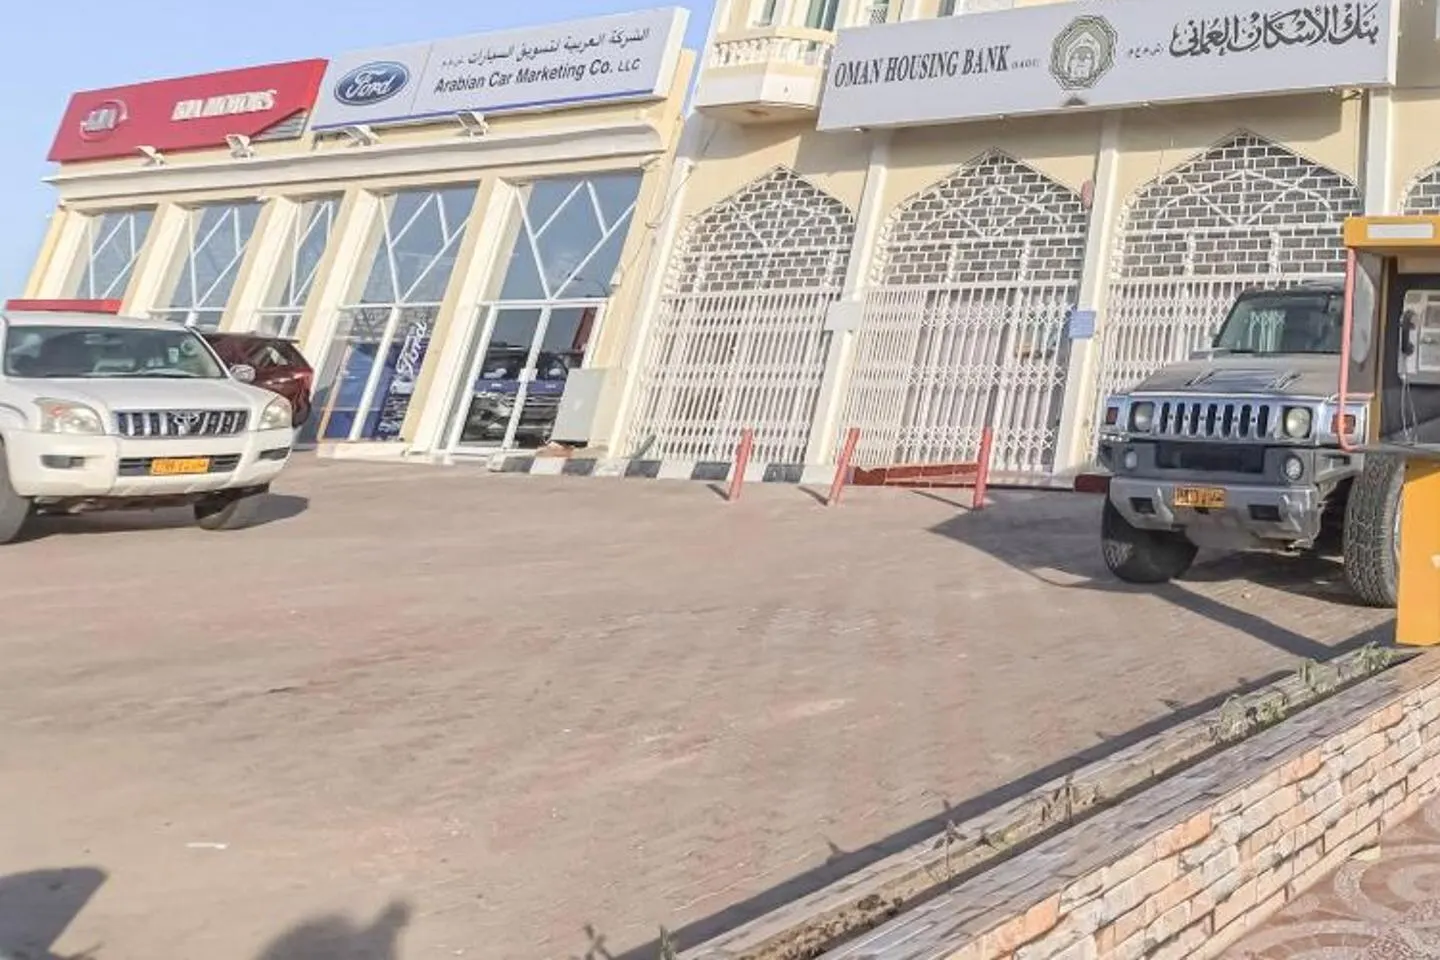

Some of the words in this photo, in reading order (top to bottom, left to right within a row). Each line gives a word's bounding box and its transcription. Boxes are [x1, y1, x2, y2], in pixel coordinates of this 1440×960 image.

[433, 75, 485, 95] Arabian
[488, 70, 515, 89] Car
[515, 62, 587, 84] Marketing
[588, 58, 614, 74] Co.
[617, 57, 641, 72] LLC
[834, 57, 884, 88] OMAN
[883, 50, 960, 83] HOUSING
[961, 44, 1011, 76] BANK
